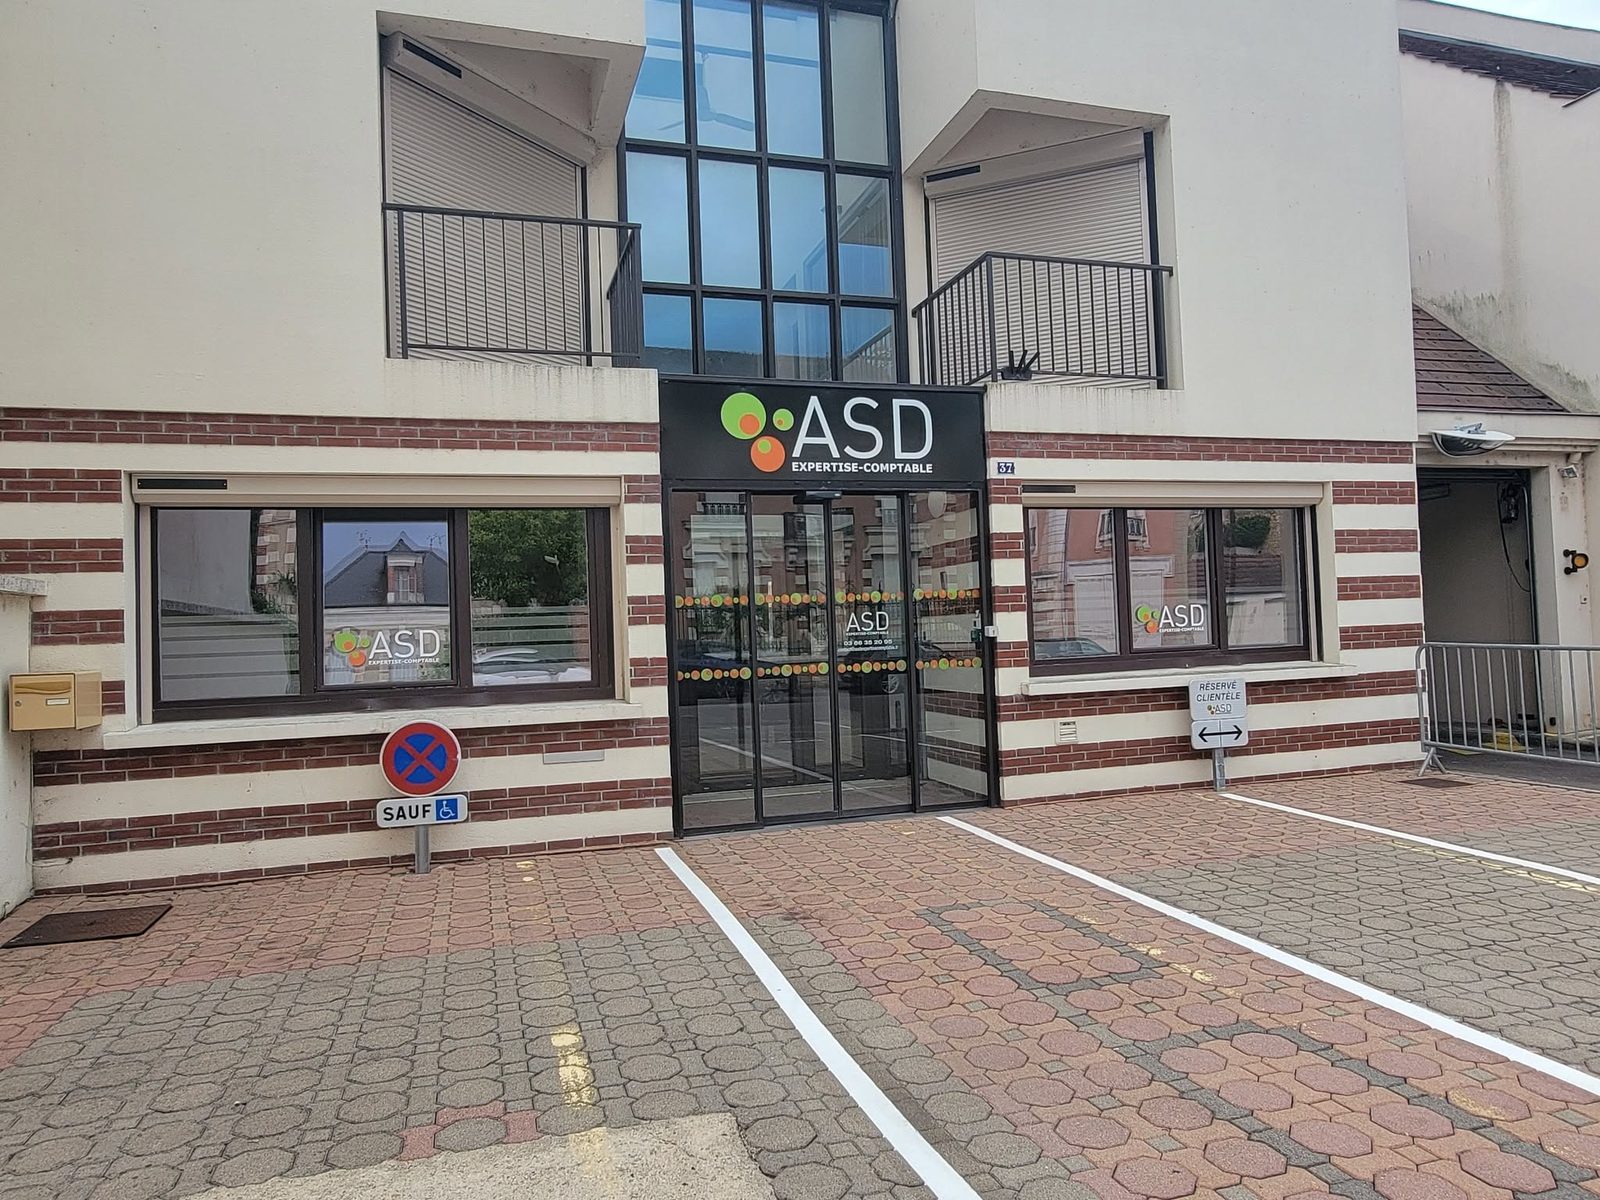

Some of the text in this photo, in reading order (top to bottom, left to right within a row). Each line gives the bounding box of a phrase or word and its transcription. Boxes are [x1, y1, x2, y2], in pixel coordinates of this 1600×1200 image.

[791, 395, 933, 460] ASD
[791, 461, 933, 474] EXPERTISE-COMPTABLE
[999, 463, 1013, 473] 37
[846, 611, 889, 631] ASD
[1159, 604, 1204, 627] ASD
[368, 629, 440, 659] ASD
[1196, 692, 1241, 702] CLIENTÈLE
[383, 803, 432, 821] SAUF
